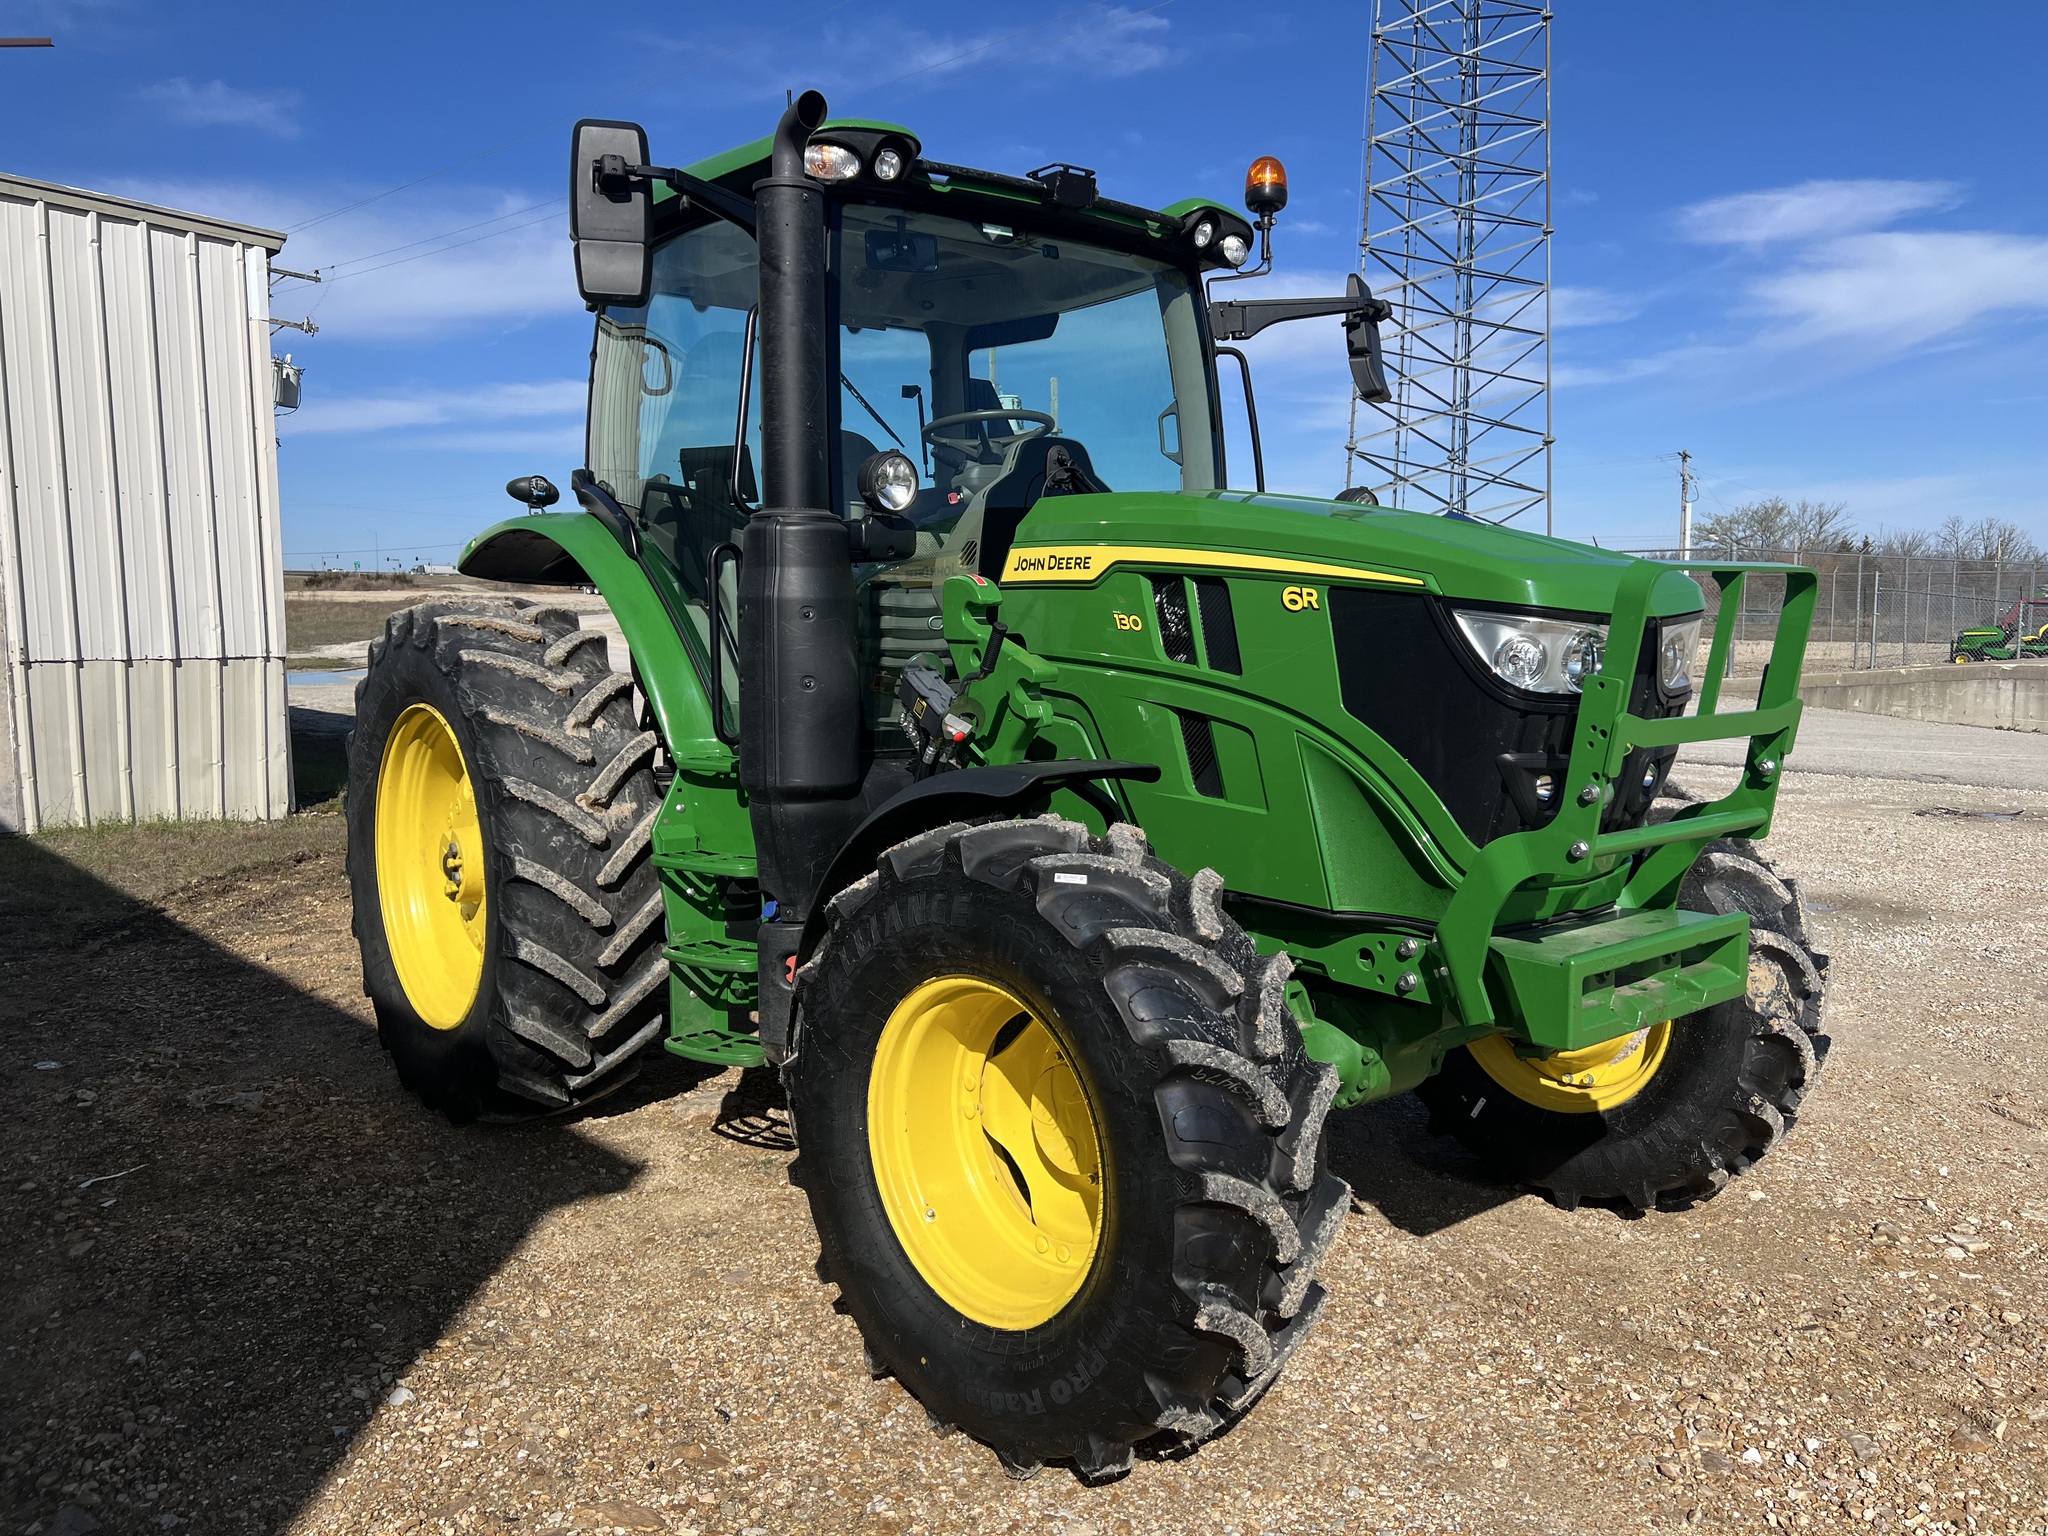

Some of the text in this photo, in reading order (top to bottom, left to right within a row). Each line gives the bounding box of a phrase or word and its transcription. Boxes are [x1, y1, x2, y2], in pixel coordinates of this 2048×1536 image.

[1013, 555, 1092, 572] JOHN DEERE
[1281, 585, 1320, 613] 6R
[1112, 613, 1143, 633] 130
[828, 890, 973, 1004] ALLIANCE
